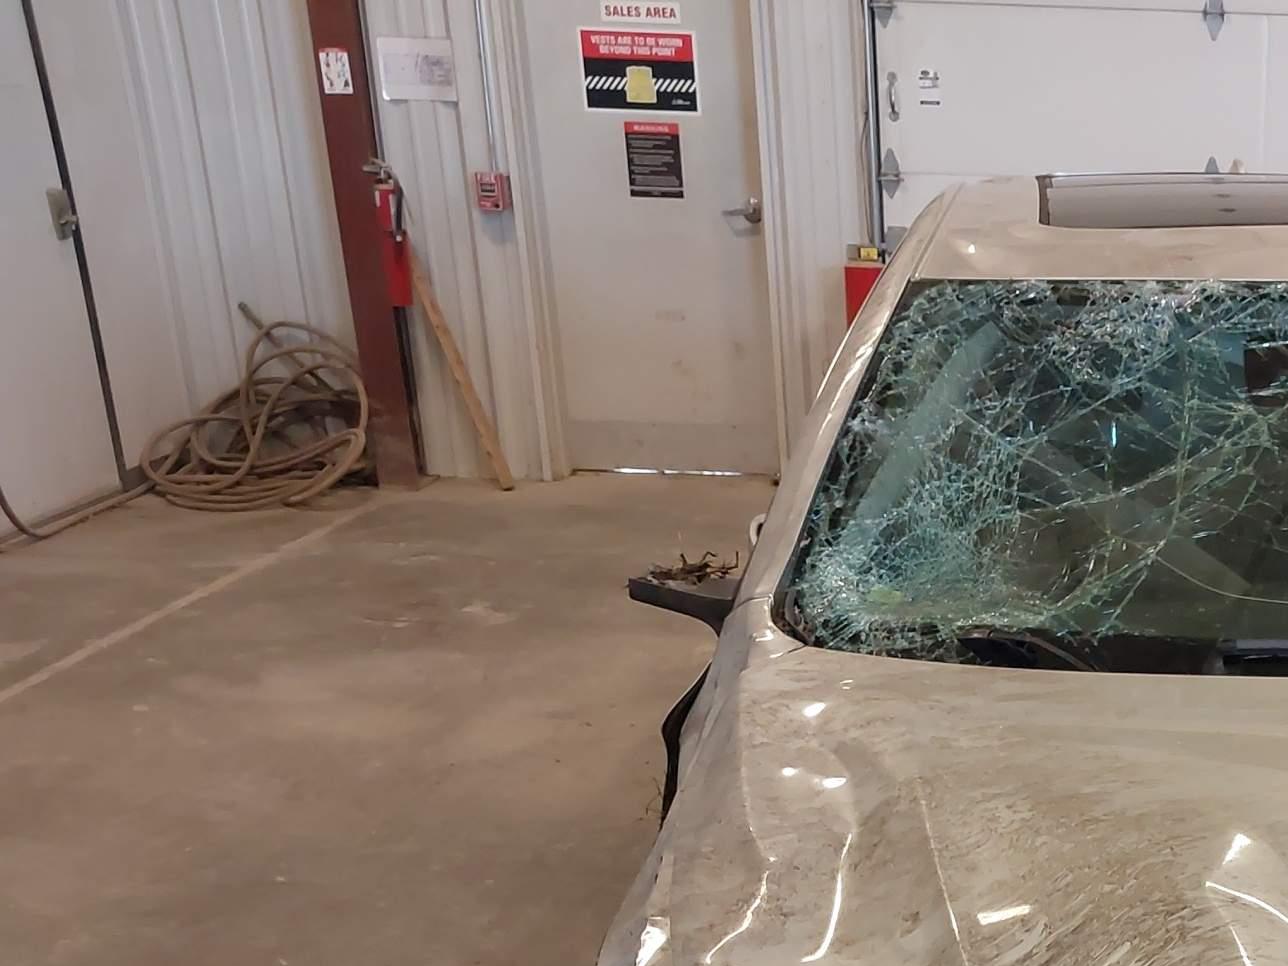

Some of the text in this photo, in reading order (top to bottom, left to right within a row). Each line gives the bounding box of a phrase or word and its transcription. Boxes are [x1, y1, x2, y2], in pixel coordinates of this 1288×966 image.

[604, 5, 677, 18] SALES AREA
[590, 35, 616, 44] VESTS
[617, 36, 632, 45] ARE
[634, 37, 645, 46] TO
[599, 45, 675, 56] BEYOND THIS POINT
